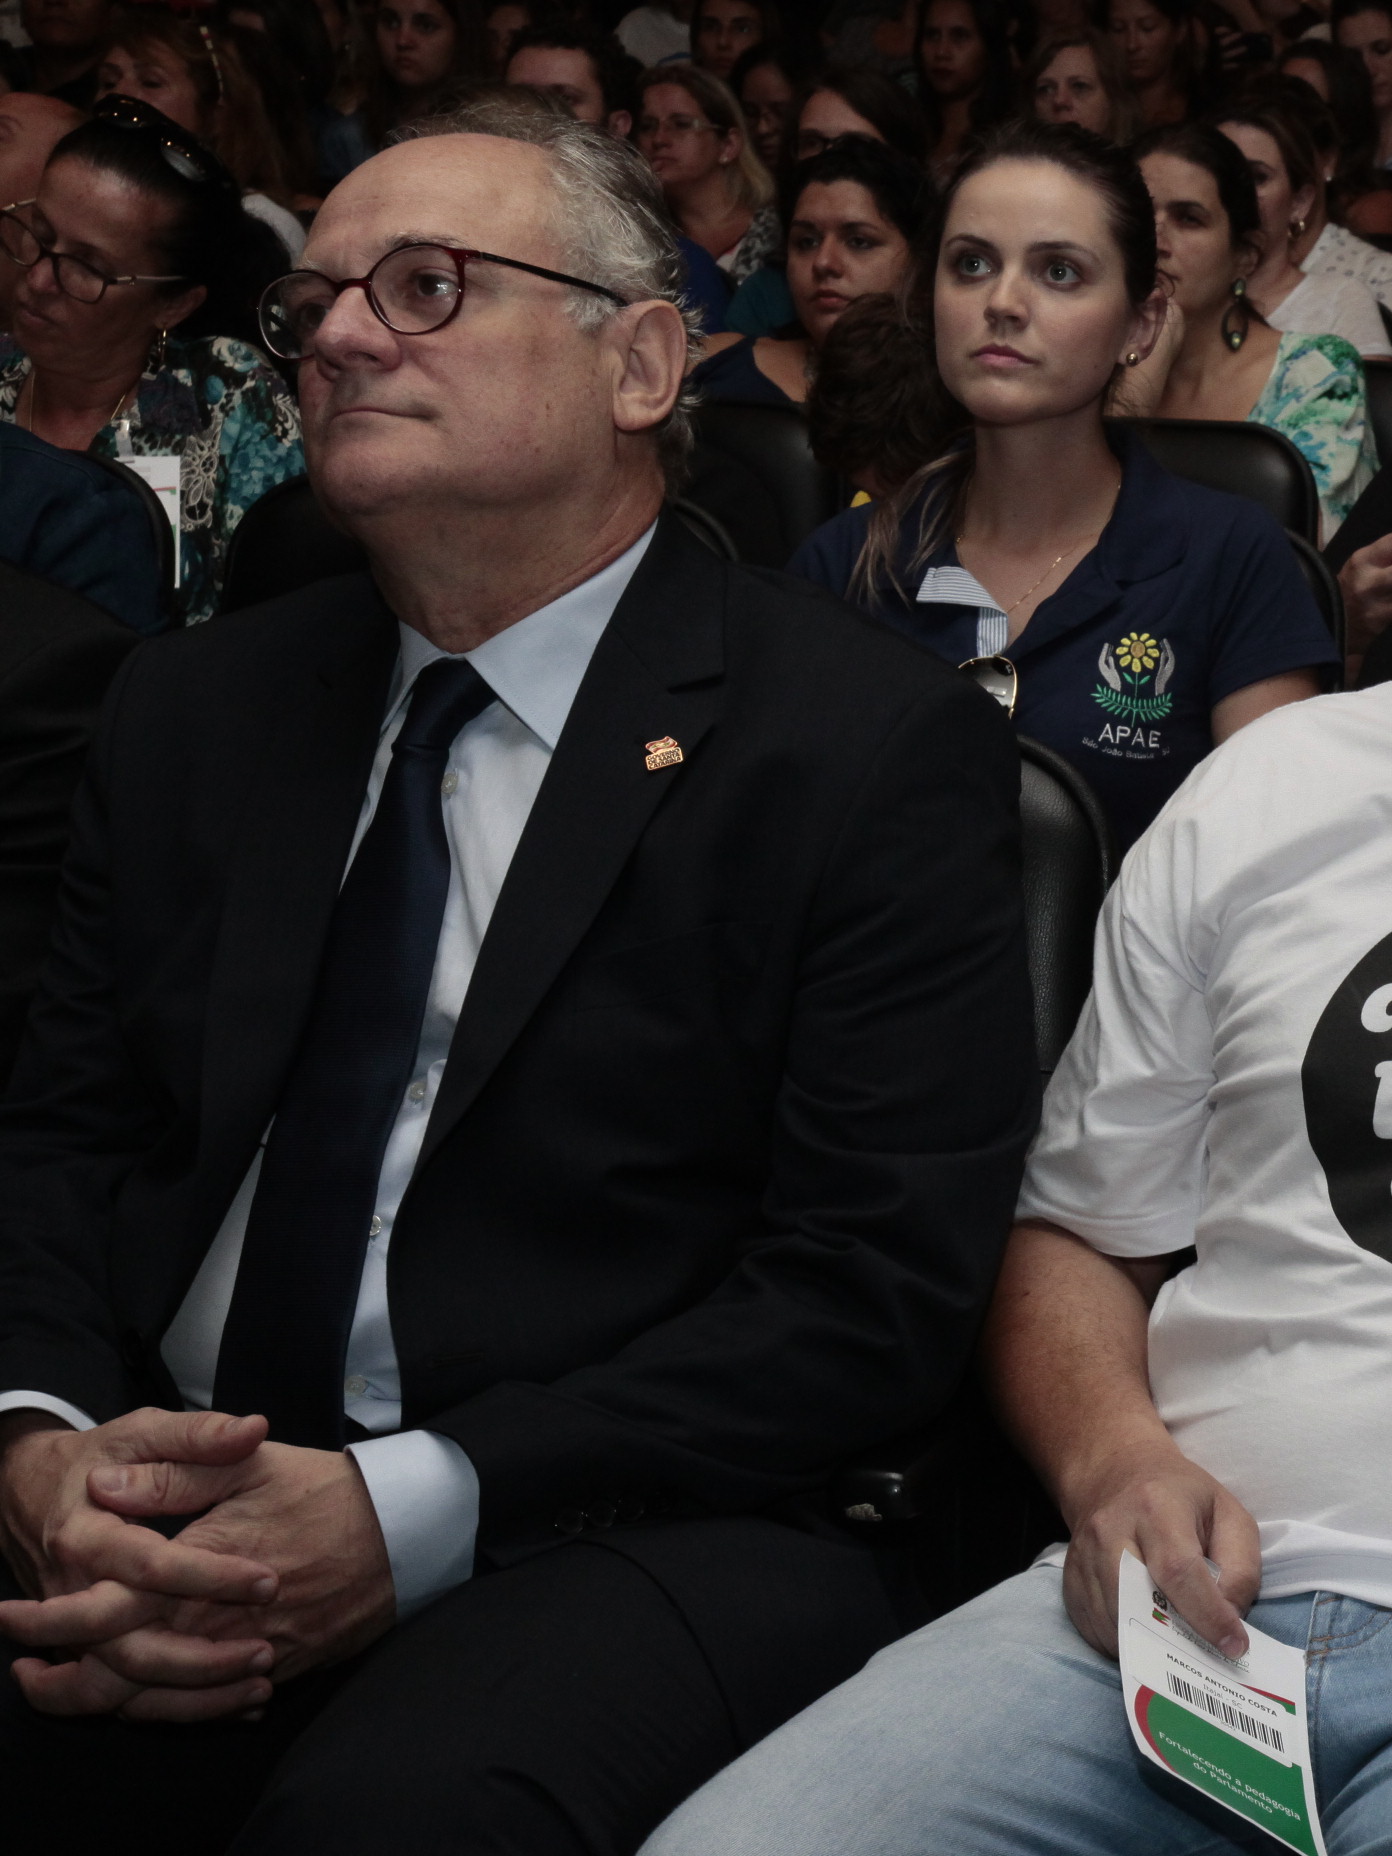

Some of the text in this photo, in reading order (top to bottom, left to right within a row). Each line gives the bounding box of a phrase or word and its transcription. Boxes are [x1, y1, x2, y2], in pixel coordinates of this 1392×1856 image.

[1098, 723, 1161, 748] APAE
[1166, 1653, 1203, 1678] MARCOS
[1205, 1676, 1246, 1701] ANTONIO
[1248, 1699, 1278, 1717] COSTA
[1159, 1731, 1301, 1821] Fortalecendo a pedagogia
[1193, 1762, 1273, 1814] do Parlamento
